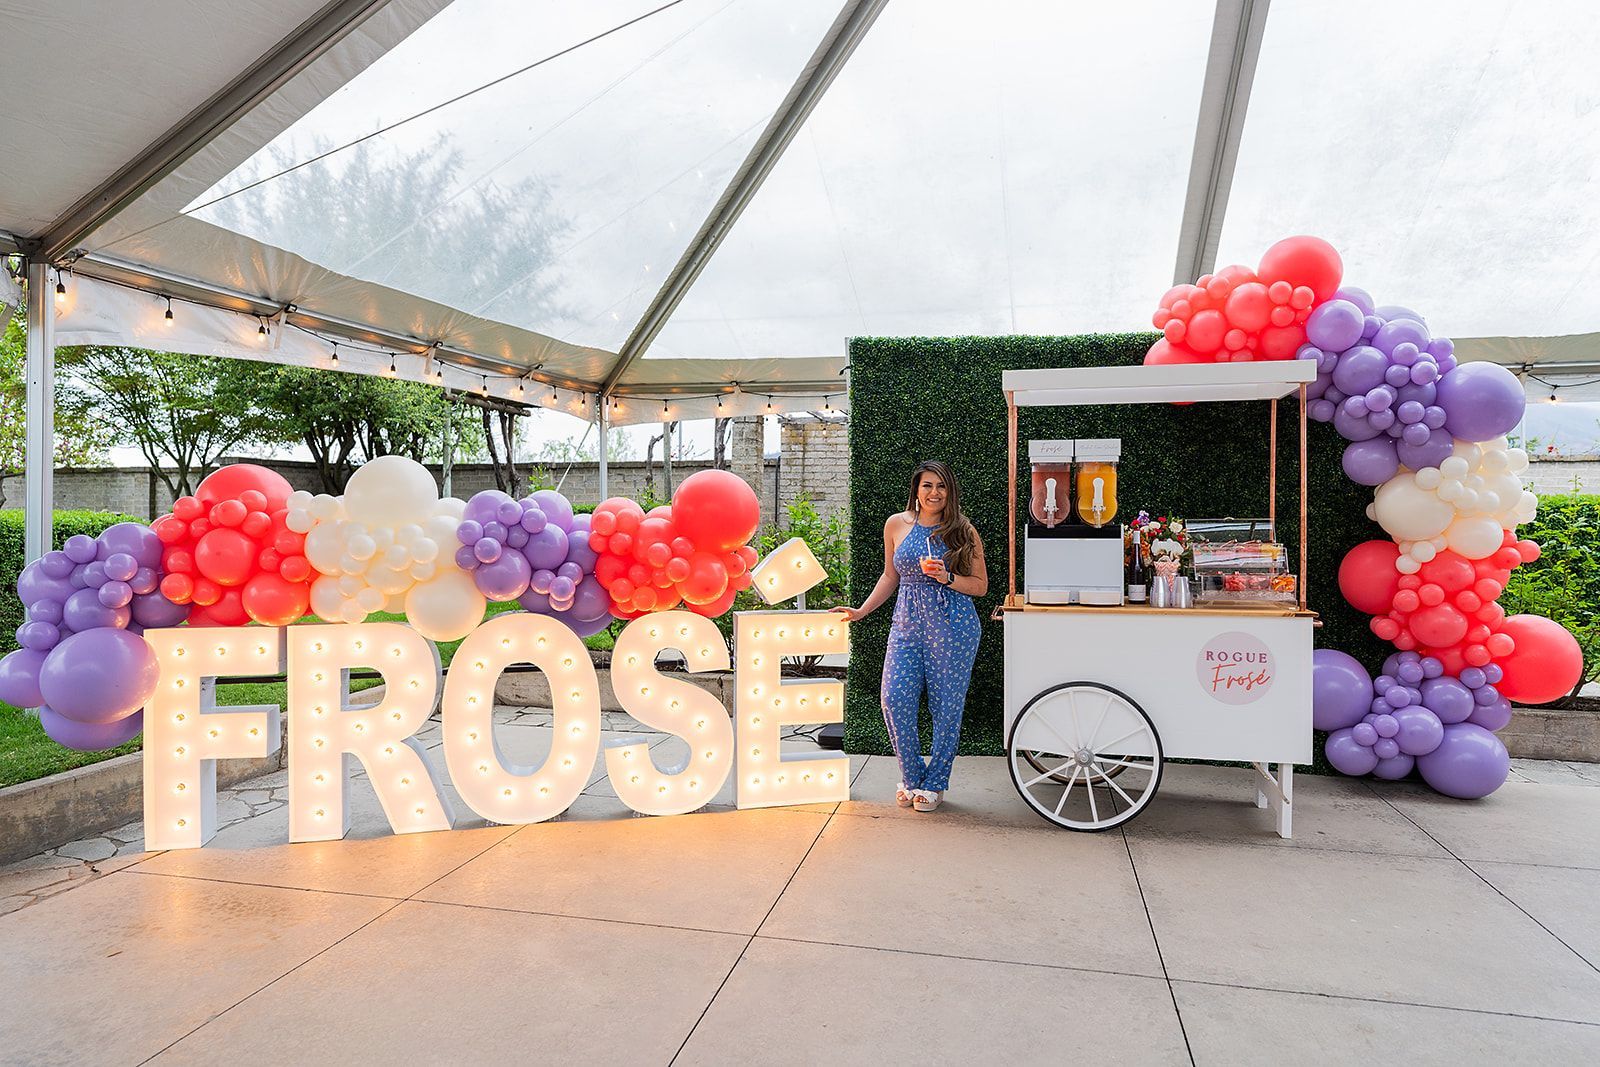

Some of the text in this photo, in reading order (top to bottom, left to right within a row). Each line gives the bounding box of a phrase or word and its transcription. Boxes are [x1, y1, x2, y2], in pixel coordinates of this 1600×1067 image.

[1205, 650, 1268, 664] ROGUE
[1211, 663, 1271, 692] Frosé
[143, 537, 851, 851] FROSÉ
